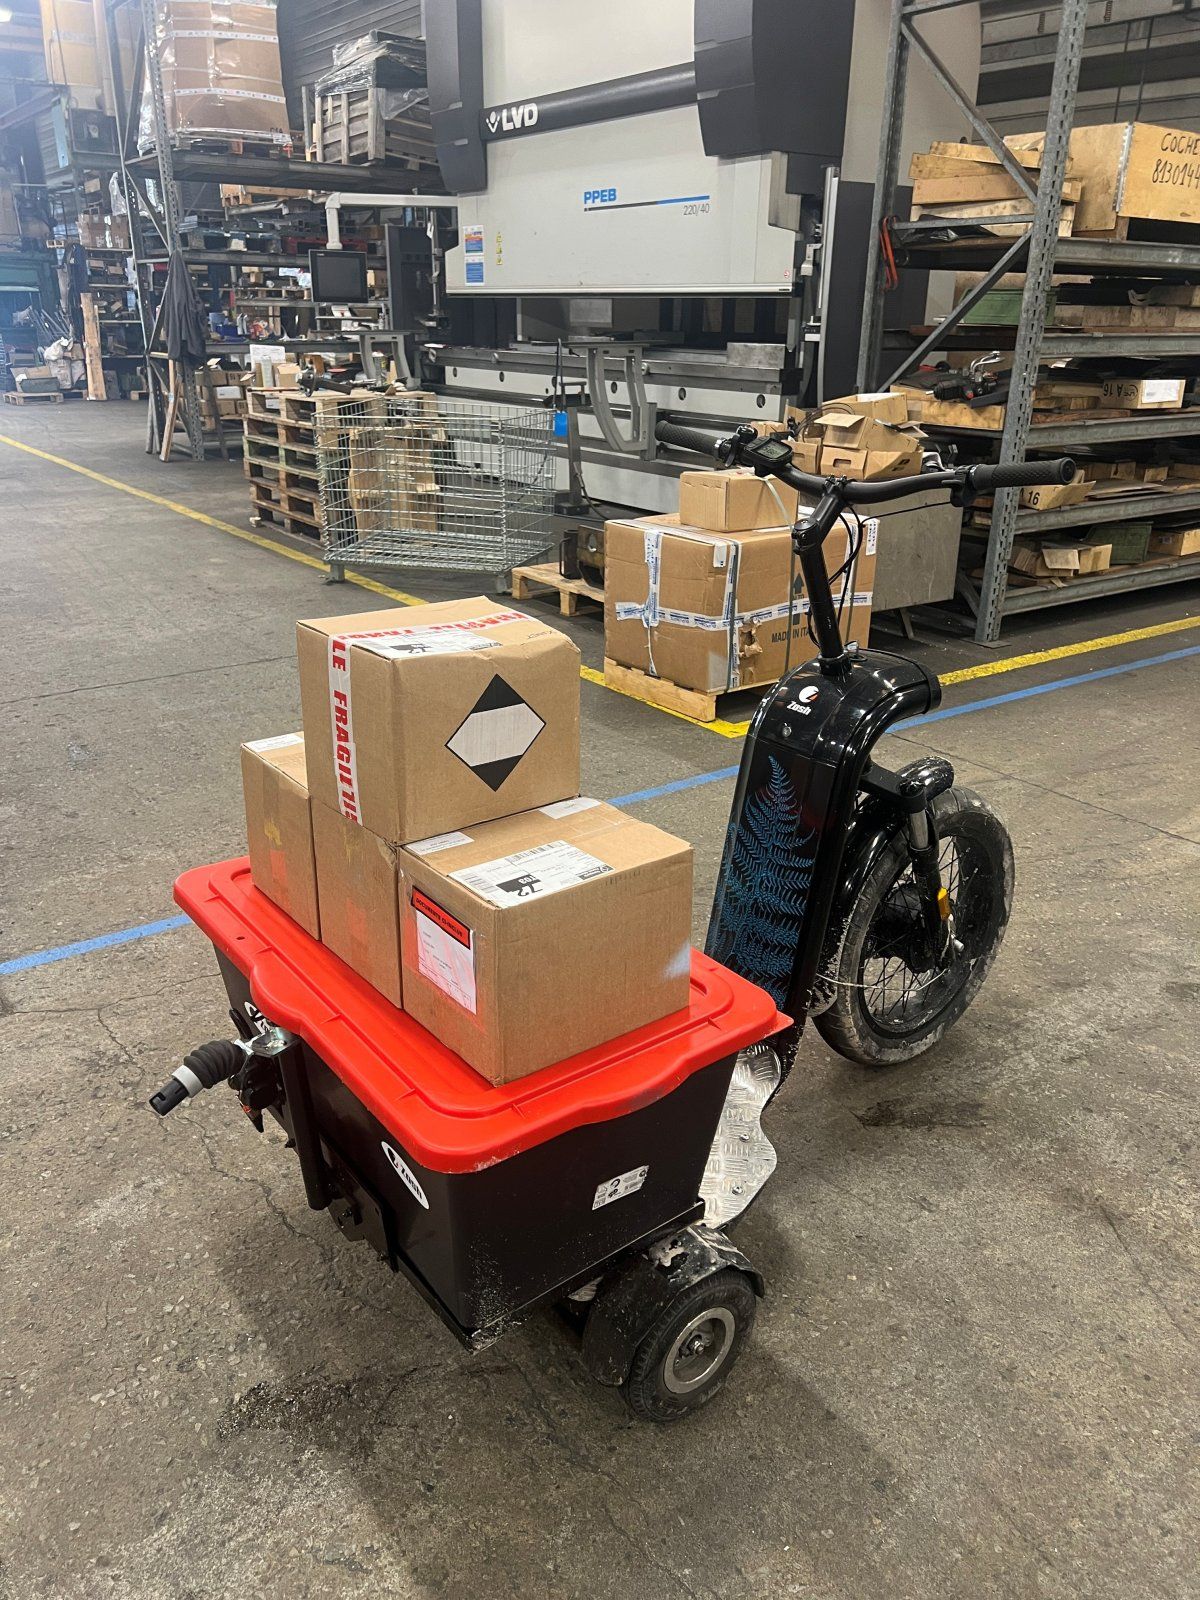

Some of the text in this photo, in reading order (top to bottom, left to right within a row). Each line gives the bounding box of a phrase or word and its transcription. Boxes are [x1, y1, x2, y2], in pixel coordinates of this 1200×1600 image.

[502, 103, 538, 131] LVD
[583, 188, 617, 204] PPEB
[683, 203, 710, 216] 220/40
[1027, 490, 1041, 505] 16
[792, 627, 800, 639] IN
[786, 701, 812, 716] Zosh
